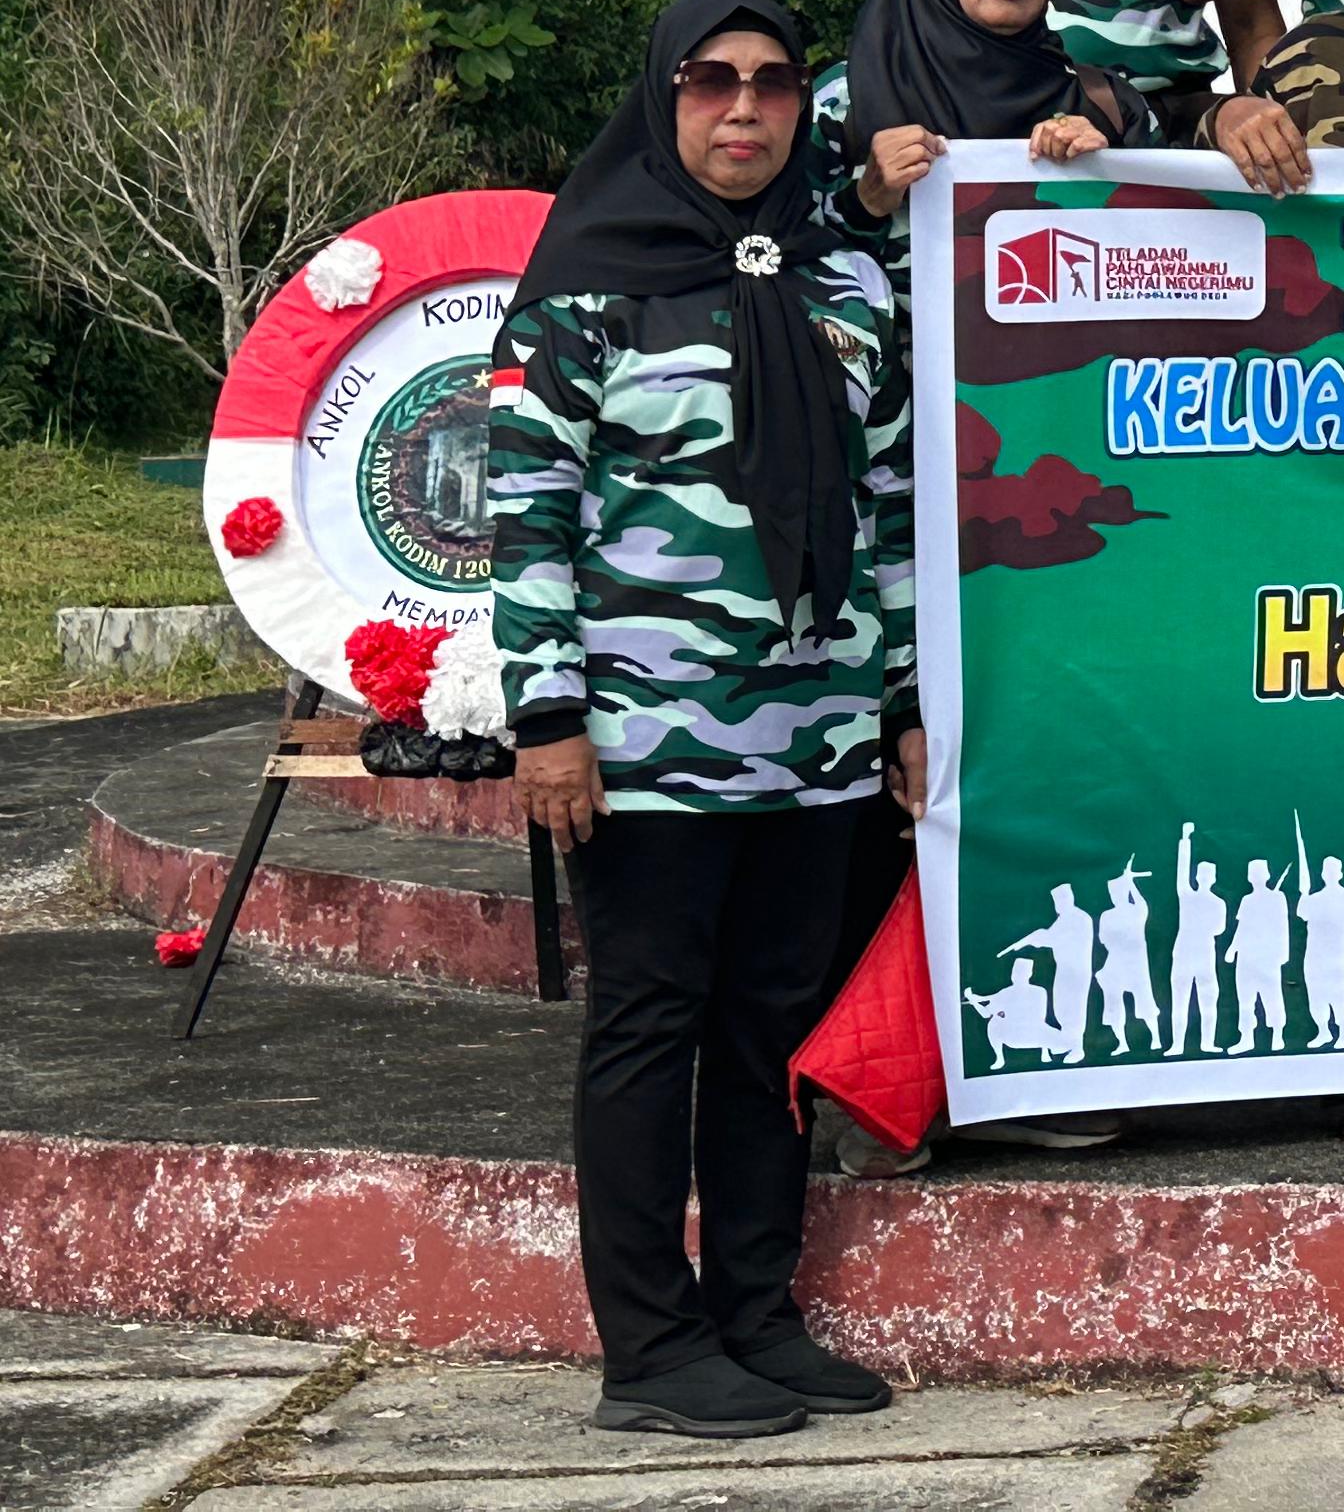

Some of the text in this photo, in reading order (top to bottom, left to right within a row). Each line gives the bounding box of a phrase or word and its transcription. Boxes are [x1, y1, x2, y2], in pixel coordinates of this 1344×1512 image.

[307, 364, 376, 460] ANKOL
[371, 442, 492, 580] ANKOL KODIM 120
